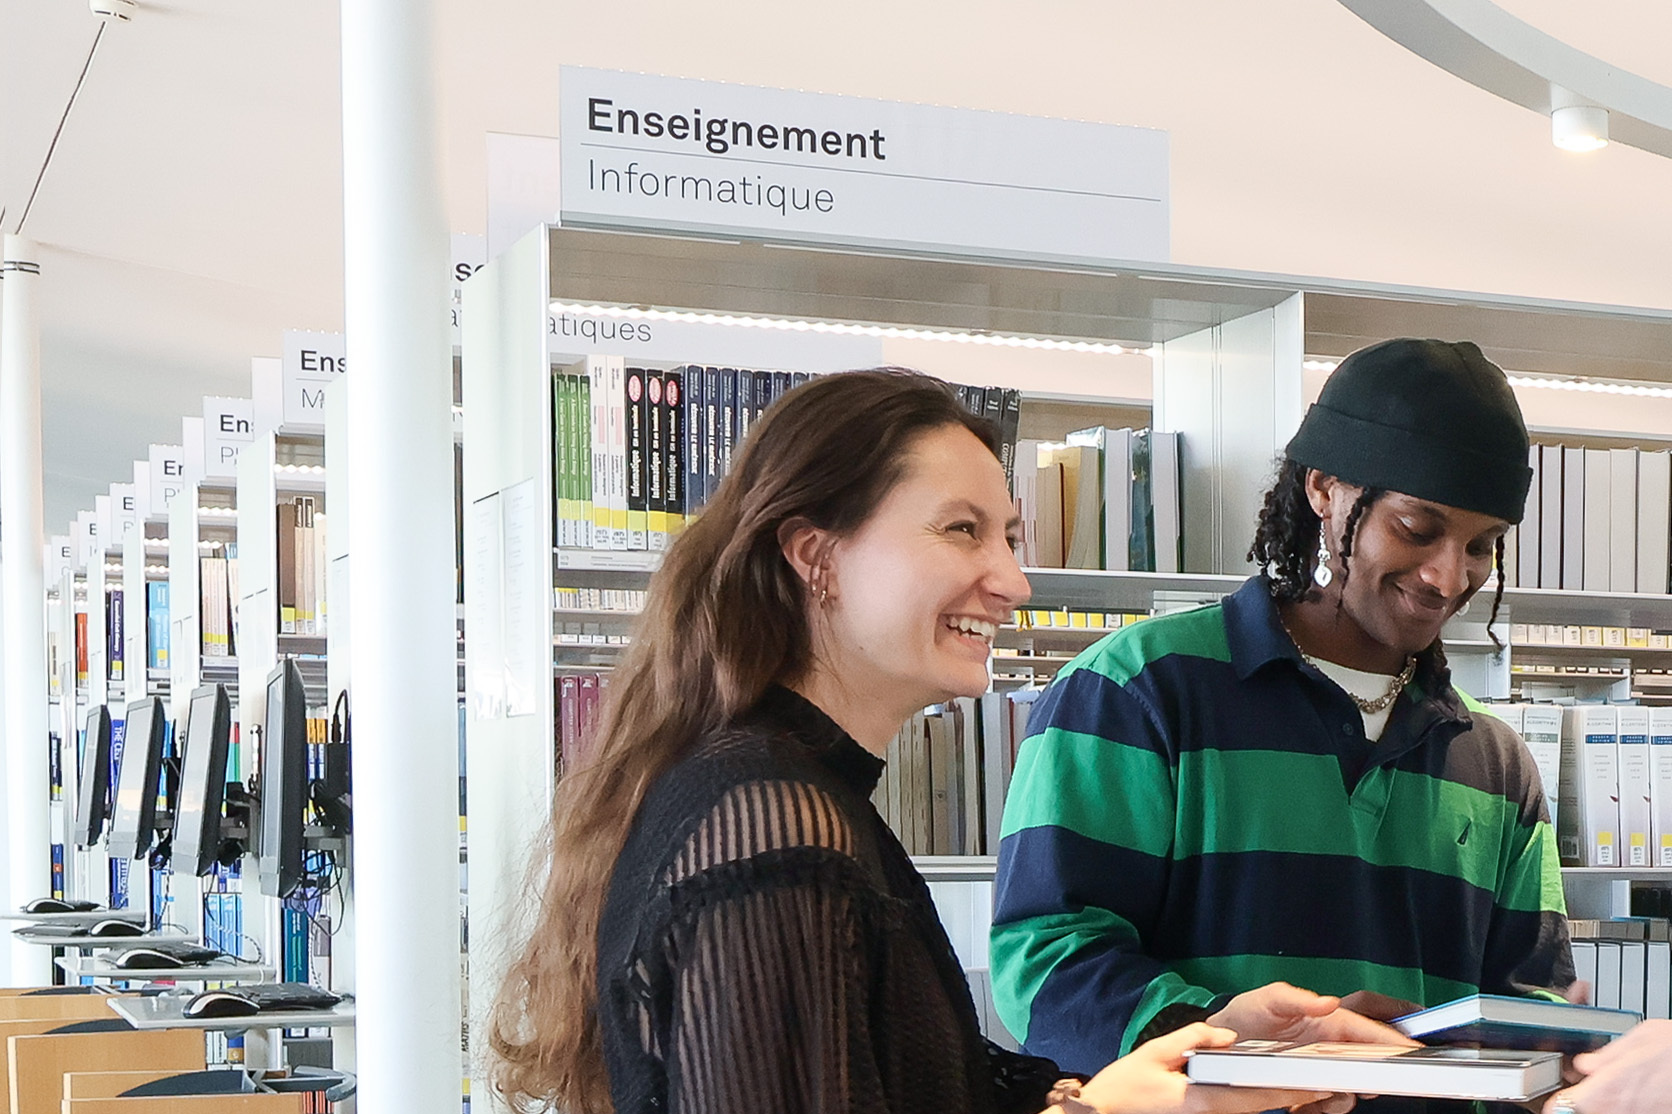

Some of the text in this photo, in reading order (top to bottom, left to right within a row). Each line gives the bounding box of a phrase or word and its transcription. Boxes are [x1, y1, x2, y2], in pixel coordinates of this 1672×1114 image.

[587, 97, 887, 161] Enseignement
[588, 159, 836, 216] Informatique
[630, 451, 641, 497] Informatique
[651, 452, 662, 498] Informatique
[668, 455, 678, 501] Informatique
